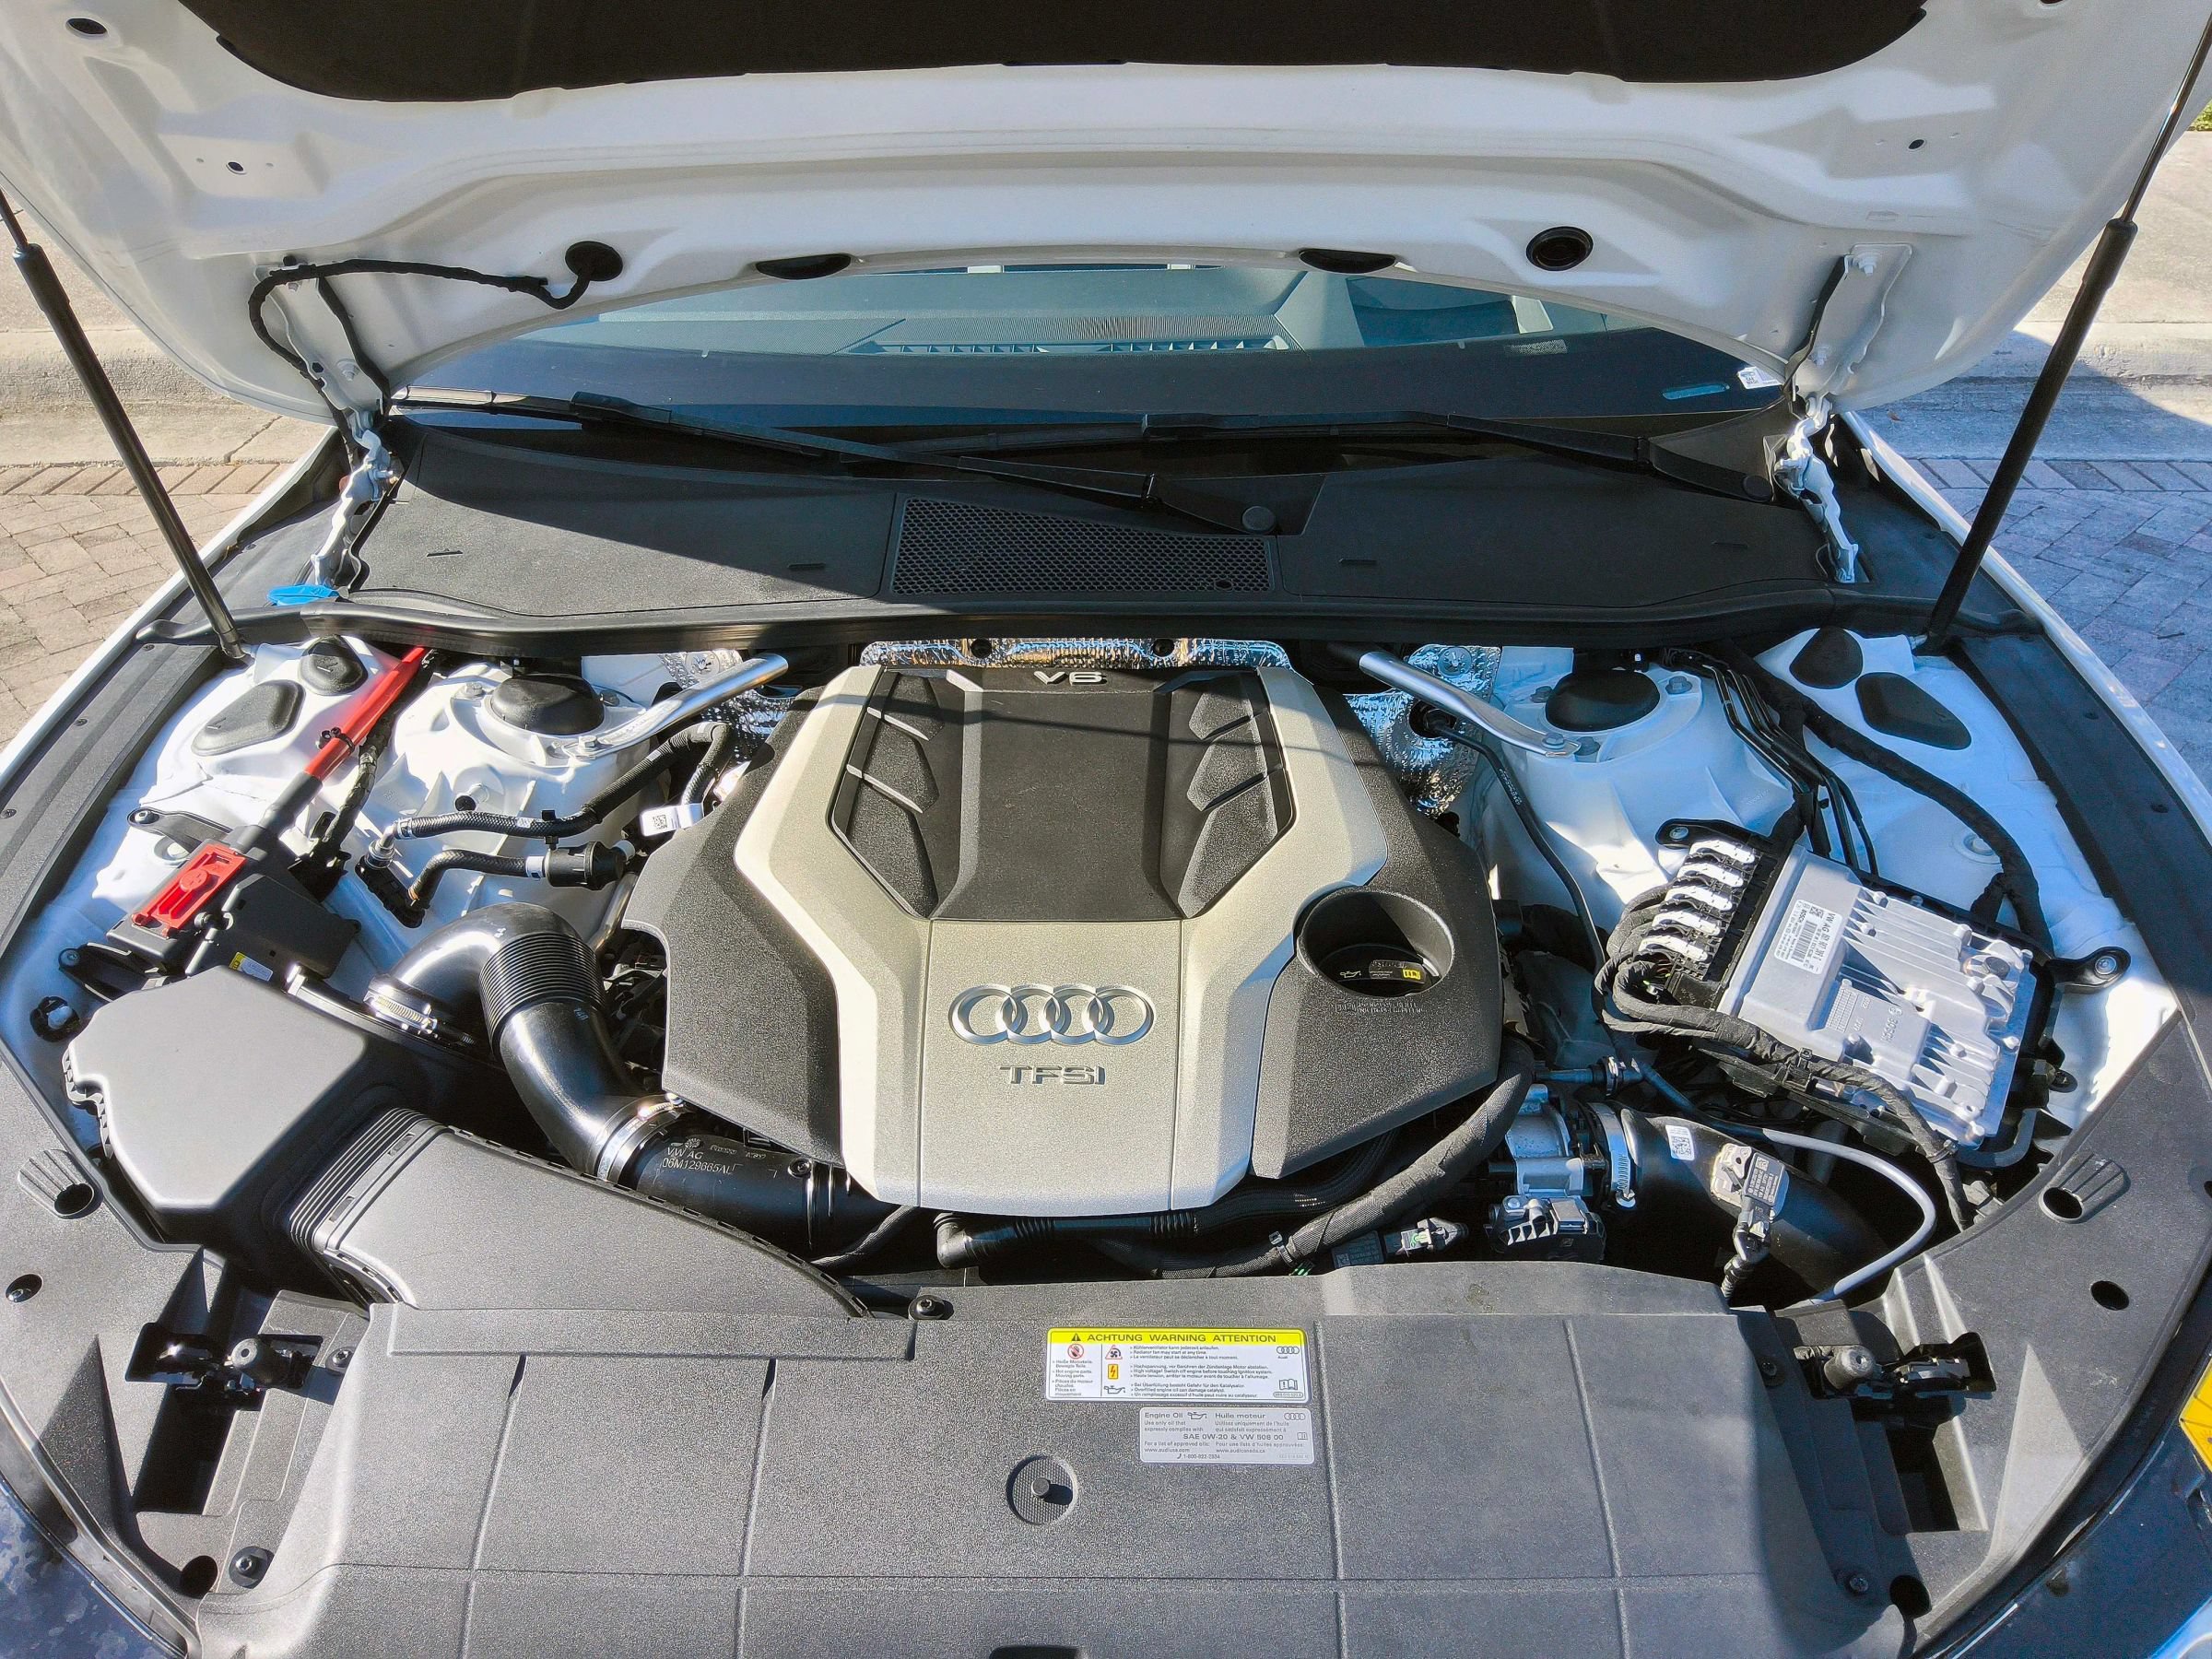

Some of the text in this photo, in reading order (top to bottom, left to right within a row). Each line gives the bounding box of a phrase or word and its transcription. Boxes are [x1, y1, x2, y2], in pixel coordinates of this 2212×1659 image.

[1034, 671, 1103, 685] V6
[1825, 913, 1835, 923] VW
[1822, 923, 1829, 933] AG
[998, 1065, 1105, 1085] TFSI
[667, 1147, 704, 1159] VW AG
